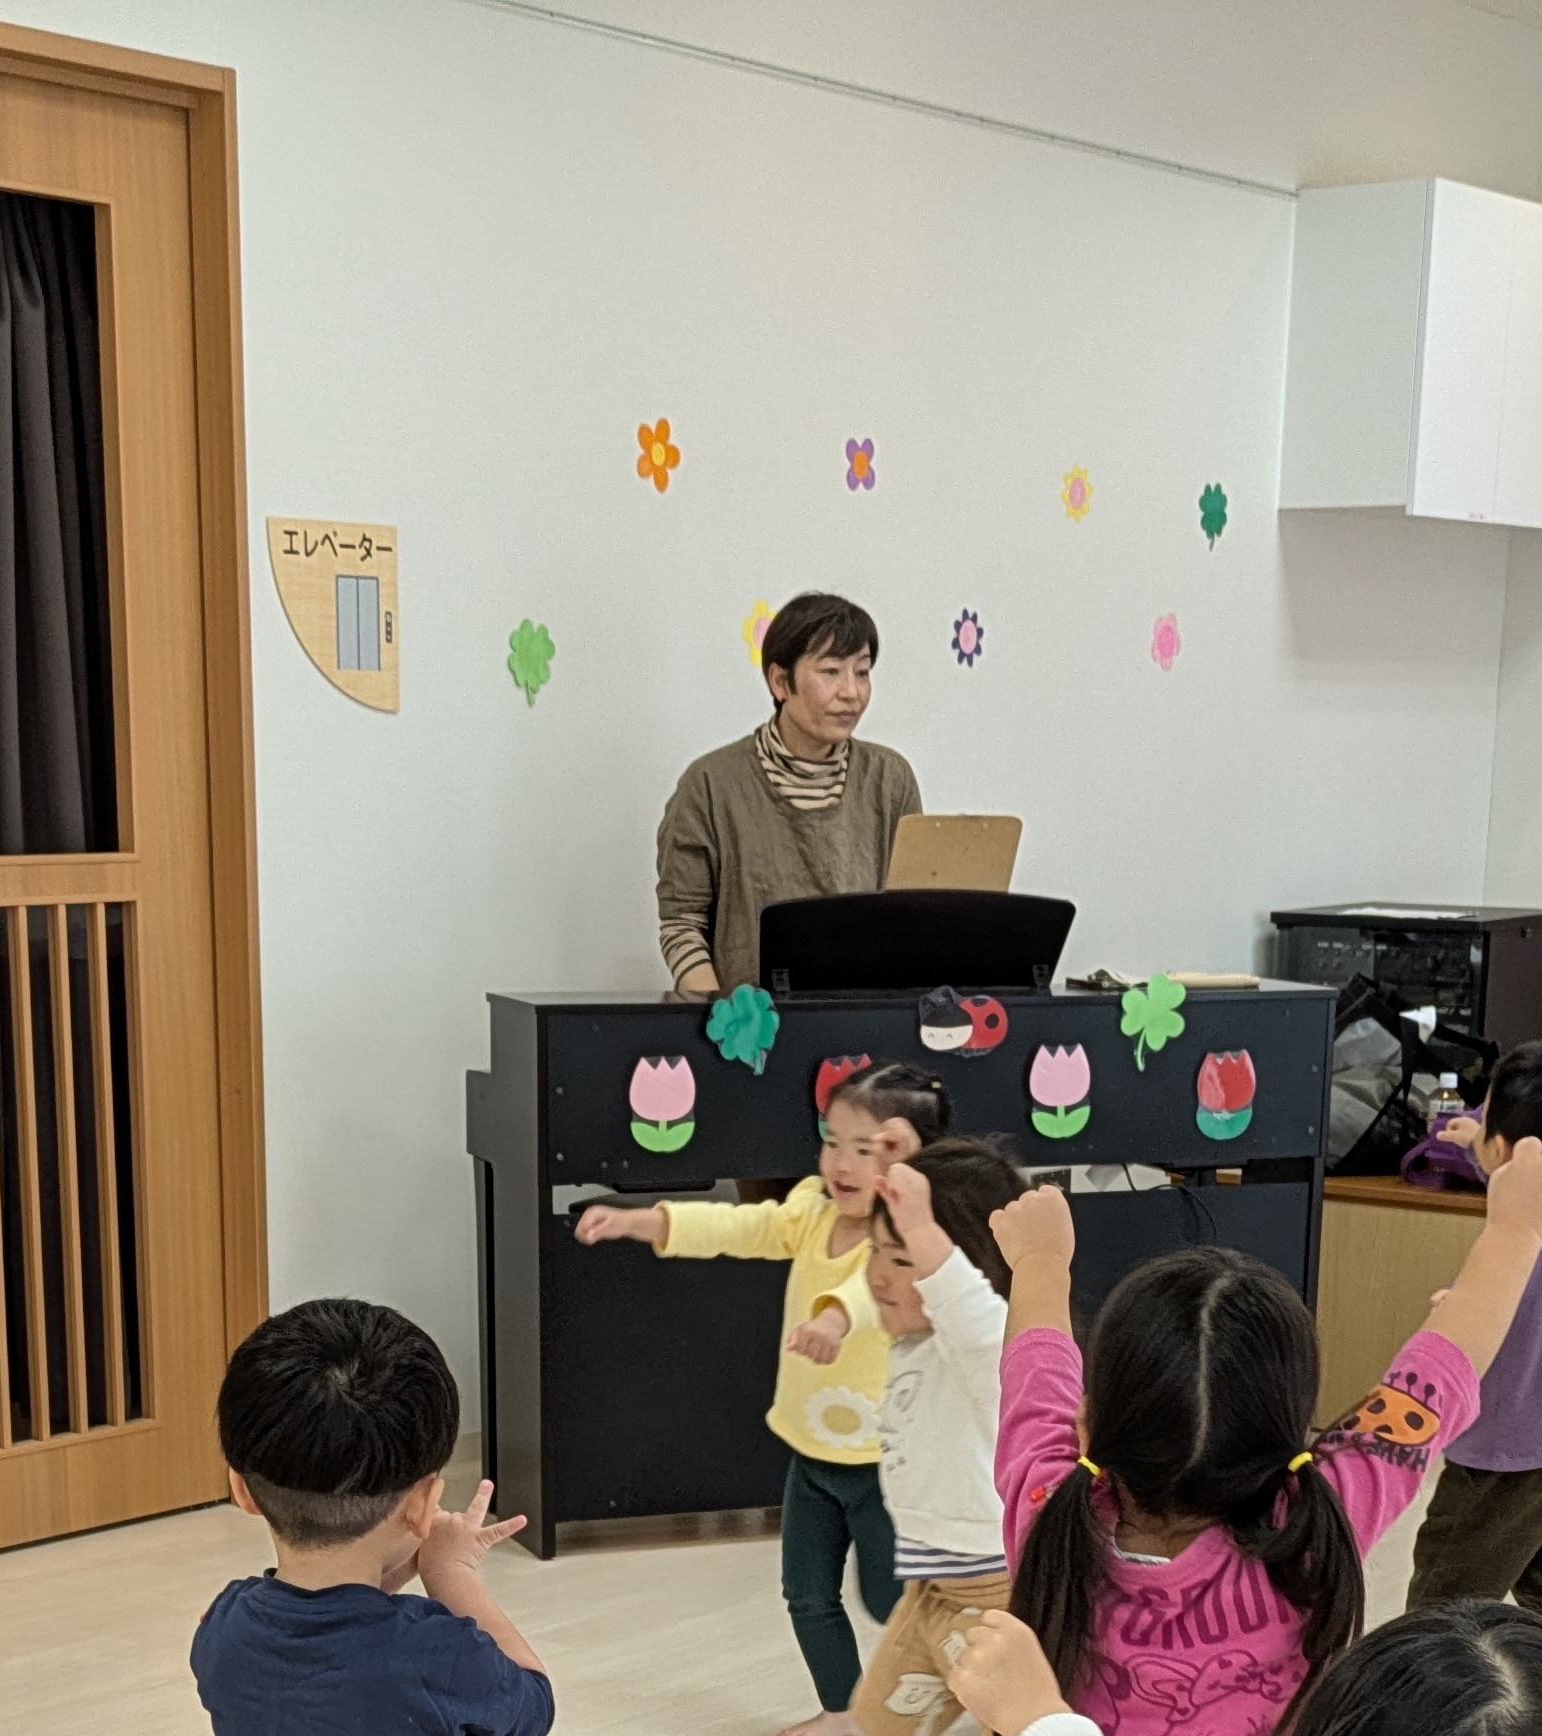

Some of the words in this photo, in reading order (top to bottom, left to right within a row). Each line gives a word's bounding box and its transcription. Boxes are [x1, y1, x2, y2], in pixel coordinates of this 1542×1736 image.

[283, 530, 393, 562] エレベーター
